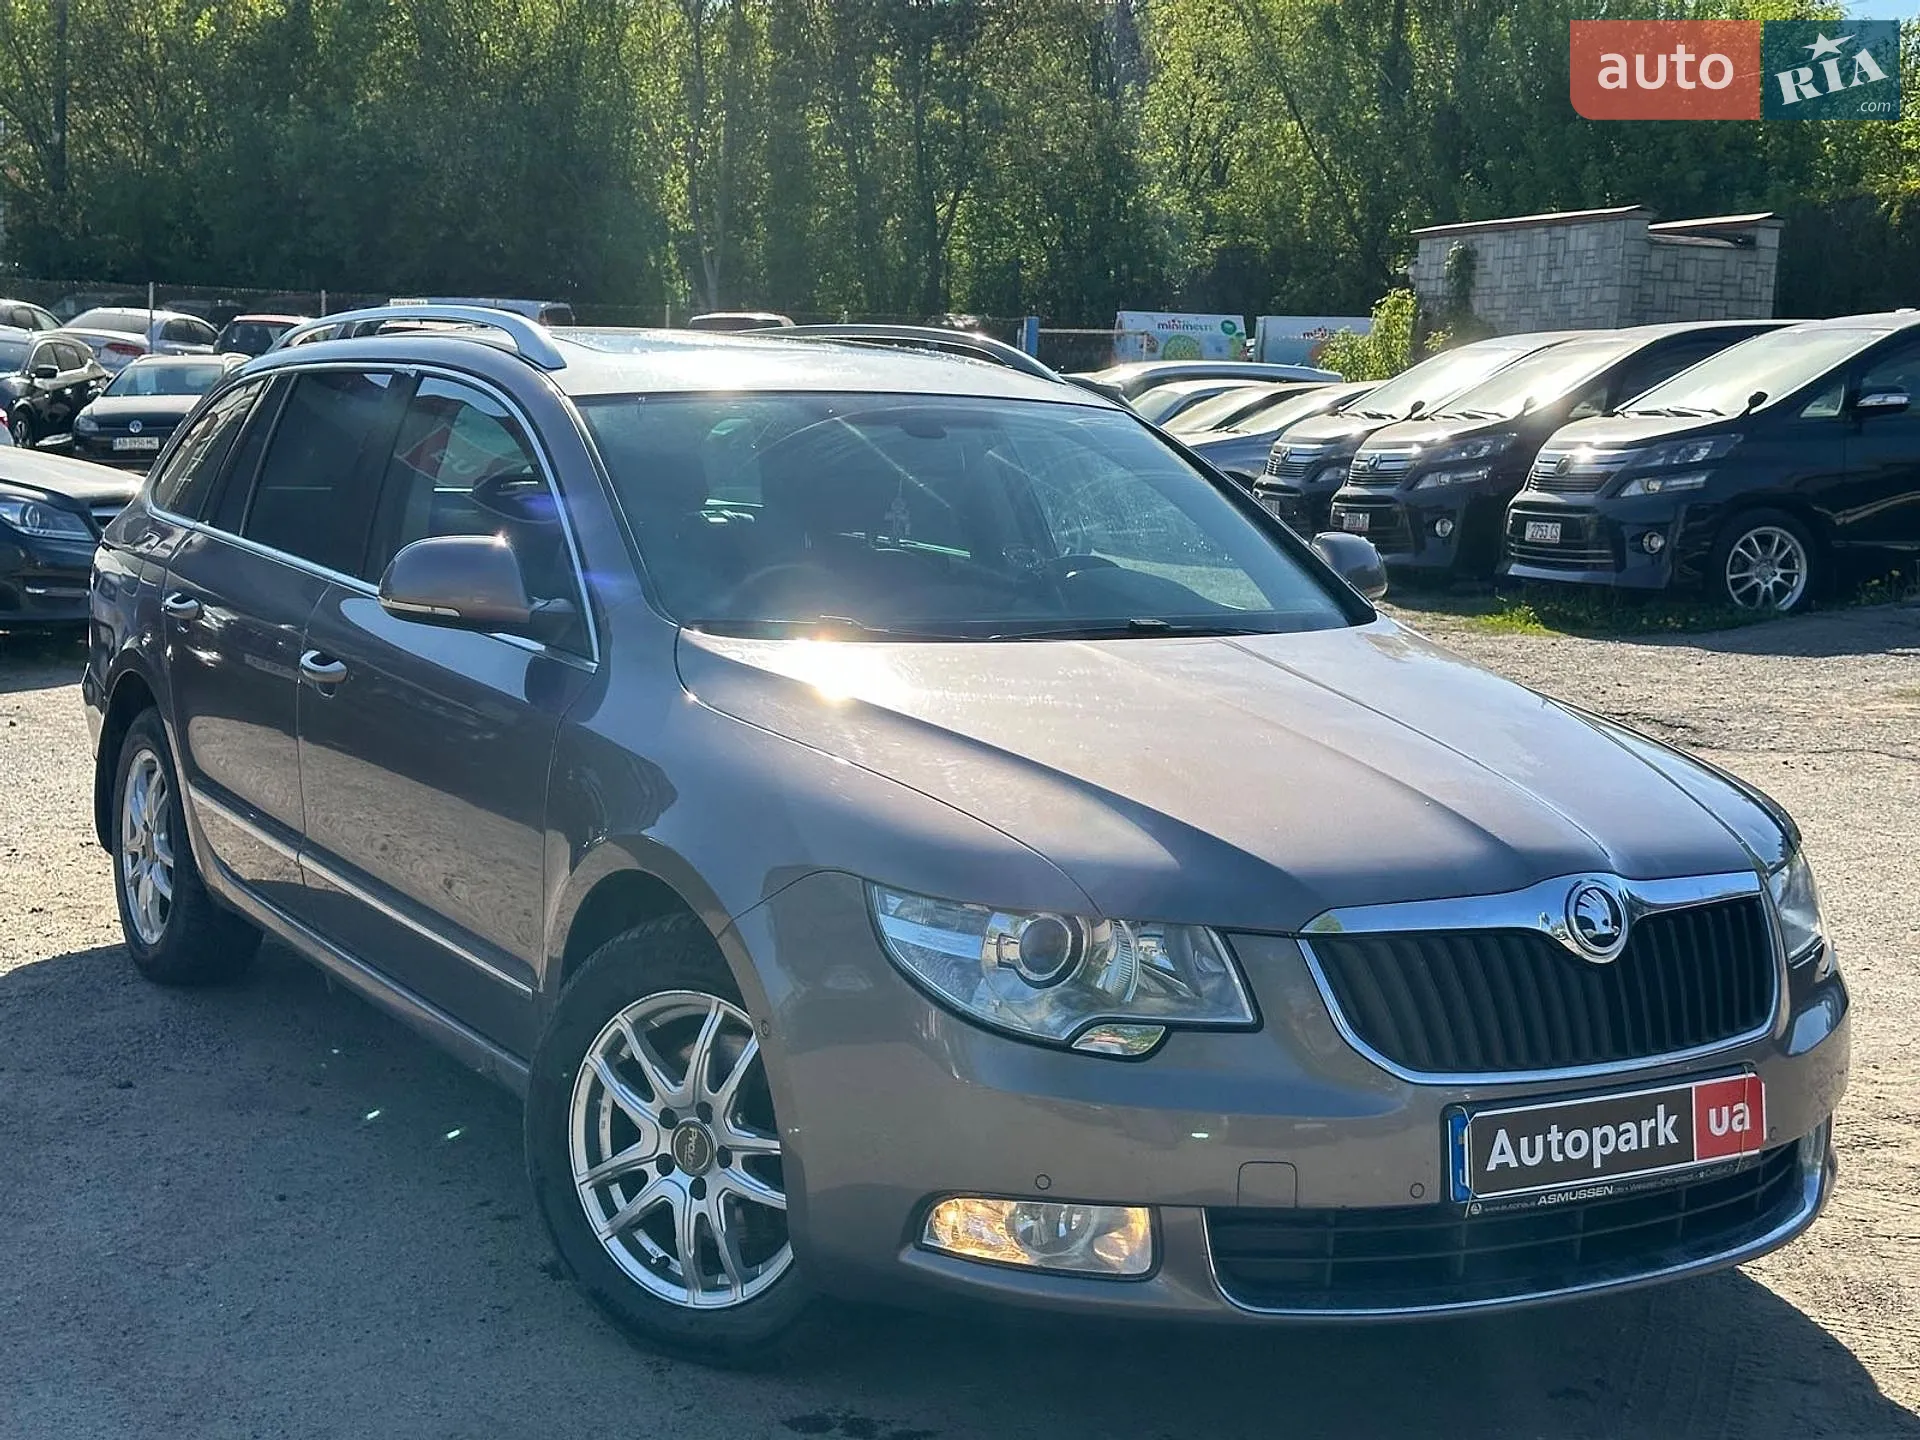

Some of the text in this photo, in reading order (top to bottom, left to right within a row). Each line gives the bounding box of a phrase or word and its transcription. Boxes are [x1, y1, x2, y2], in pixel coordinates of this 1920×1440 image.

[1486, 1101, 1751, 1172] Autopark ua
[1537, 1186, 1613, 1206] ASMUSSEN
